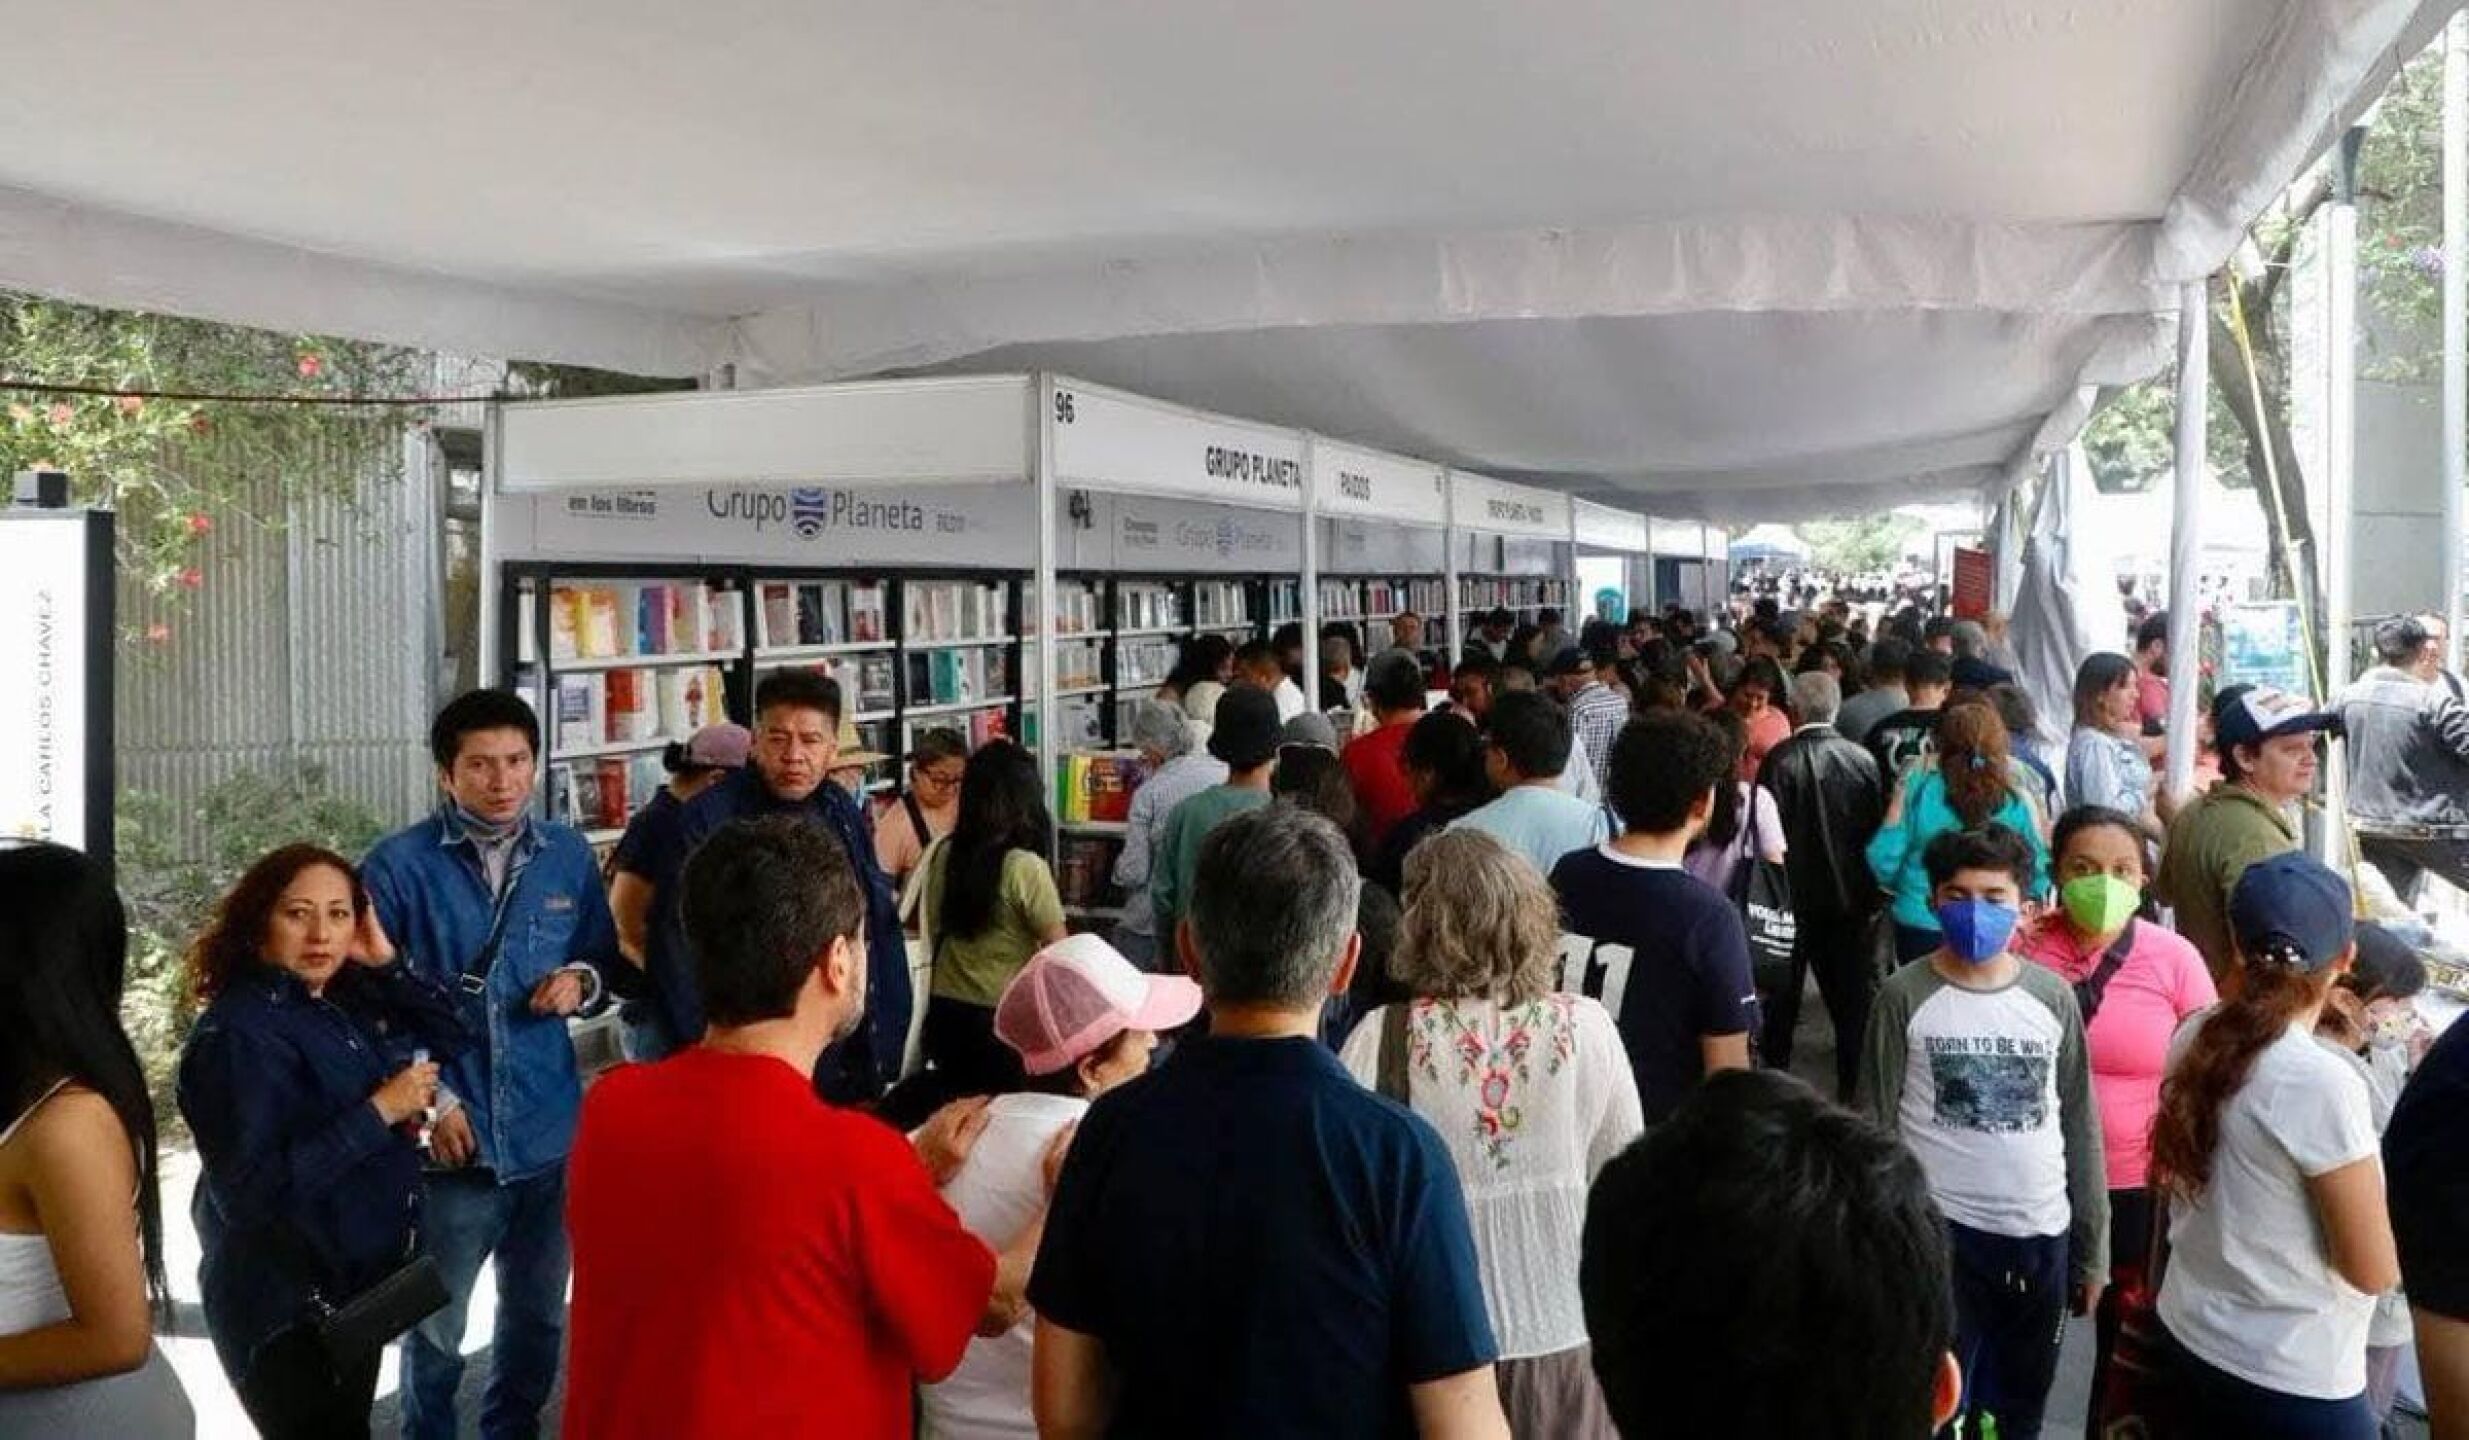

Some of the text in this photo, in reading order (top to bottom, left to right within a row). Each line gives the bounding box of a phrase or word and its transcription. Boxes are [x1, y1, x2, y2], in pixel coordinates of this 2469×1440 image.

[1055, 391, 1075, 424] 96
[1206, 446, 1302, 490] GRUPO PLANETA
[706, 489, 787, 531] Grupo
[832, 489, 924, 532] Planeta
[38, 694, 52, 796] CARLOS
[38, 803, 52, 842] LA
[1925, 1036, 1968, 1053] BORN
[1972, 1036, 1993, 1053] TO
[1997, 1036, 2015, 1055] BE
